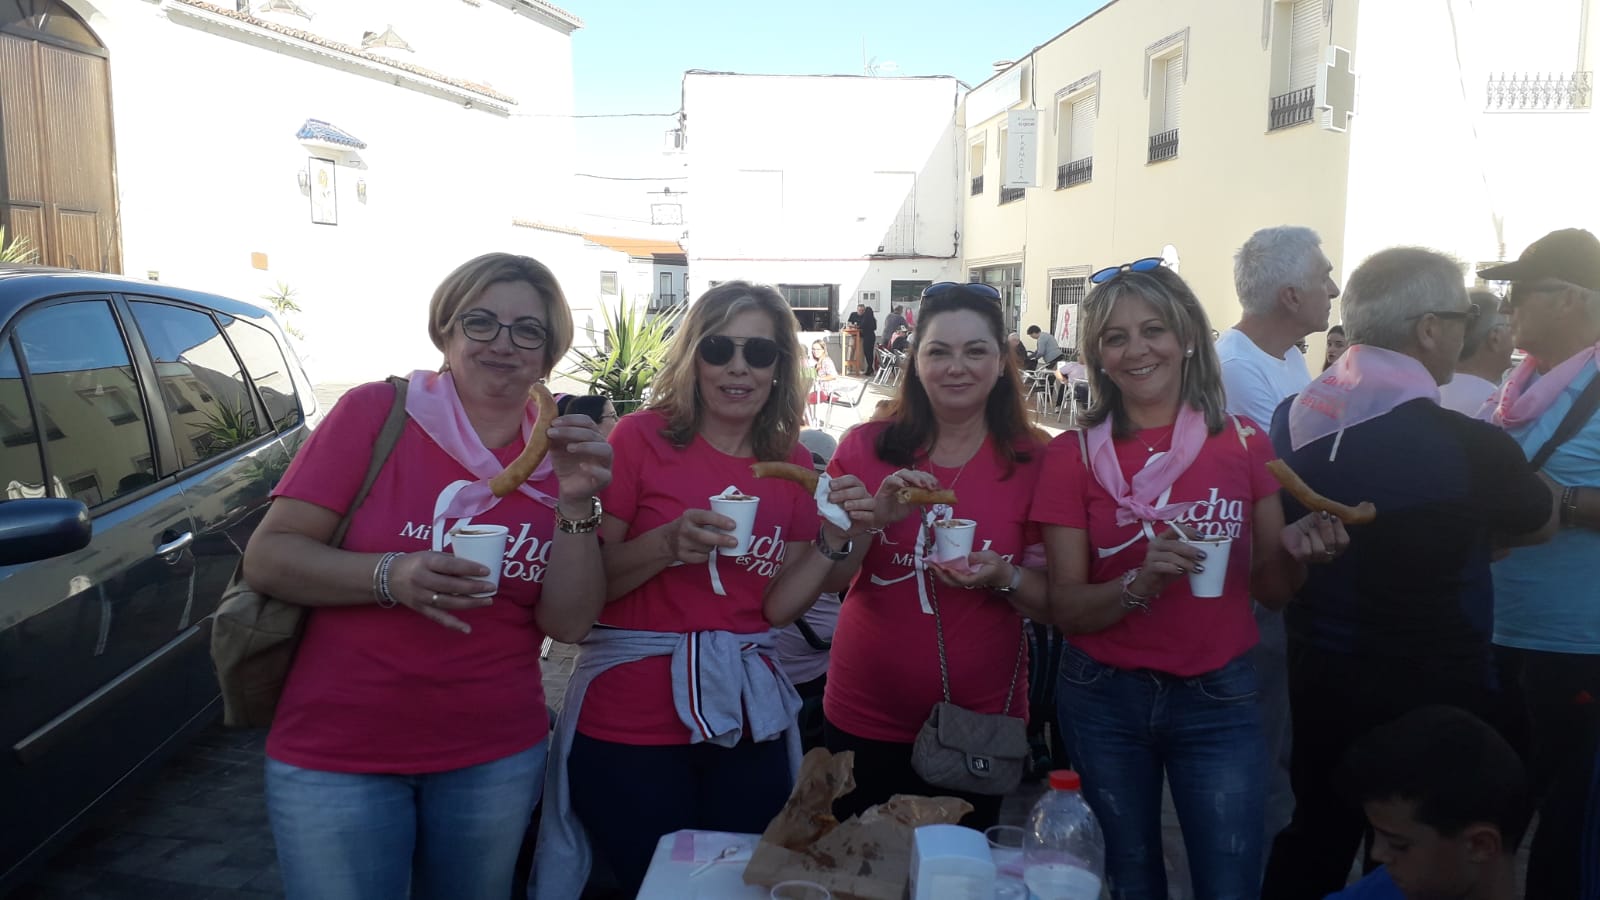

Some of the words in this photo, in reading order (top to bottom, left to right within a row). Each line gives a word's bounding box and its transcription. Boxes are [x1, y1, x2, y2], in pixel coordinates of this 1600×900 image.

[399, 521, 432, 540] Mi
[735, 554, 751, 566] es
[747, 557, 781, 578] ros
[891, 552, 914, 567] Mi
